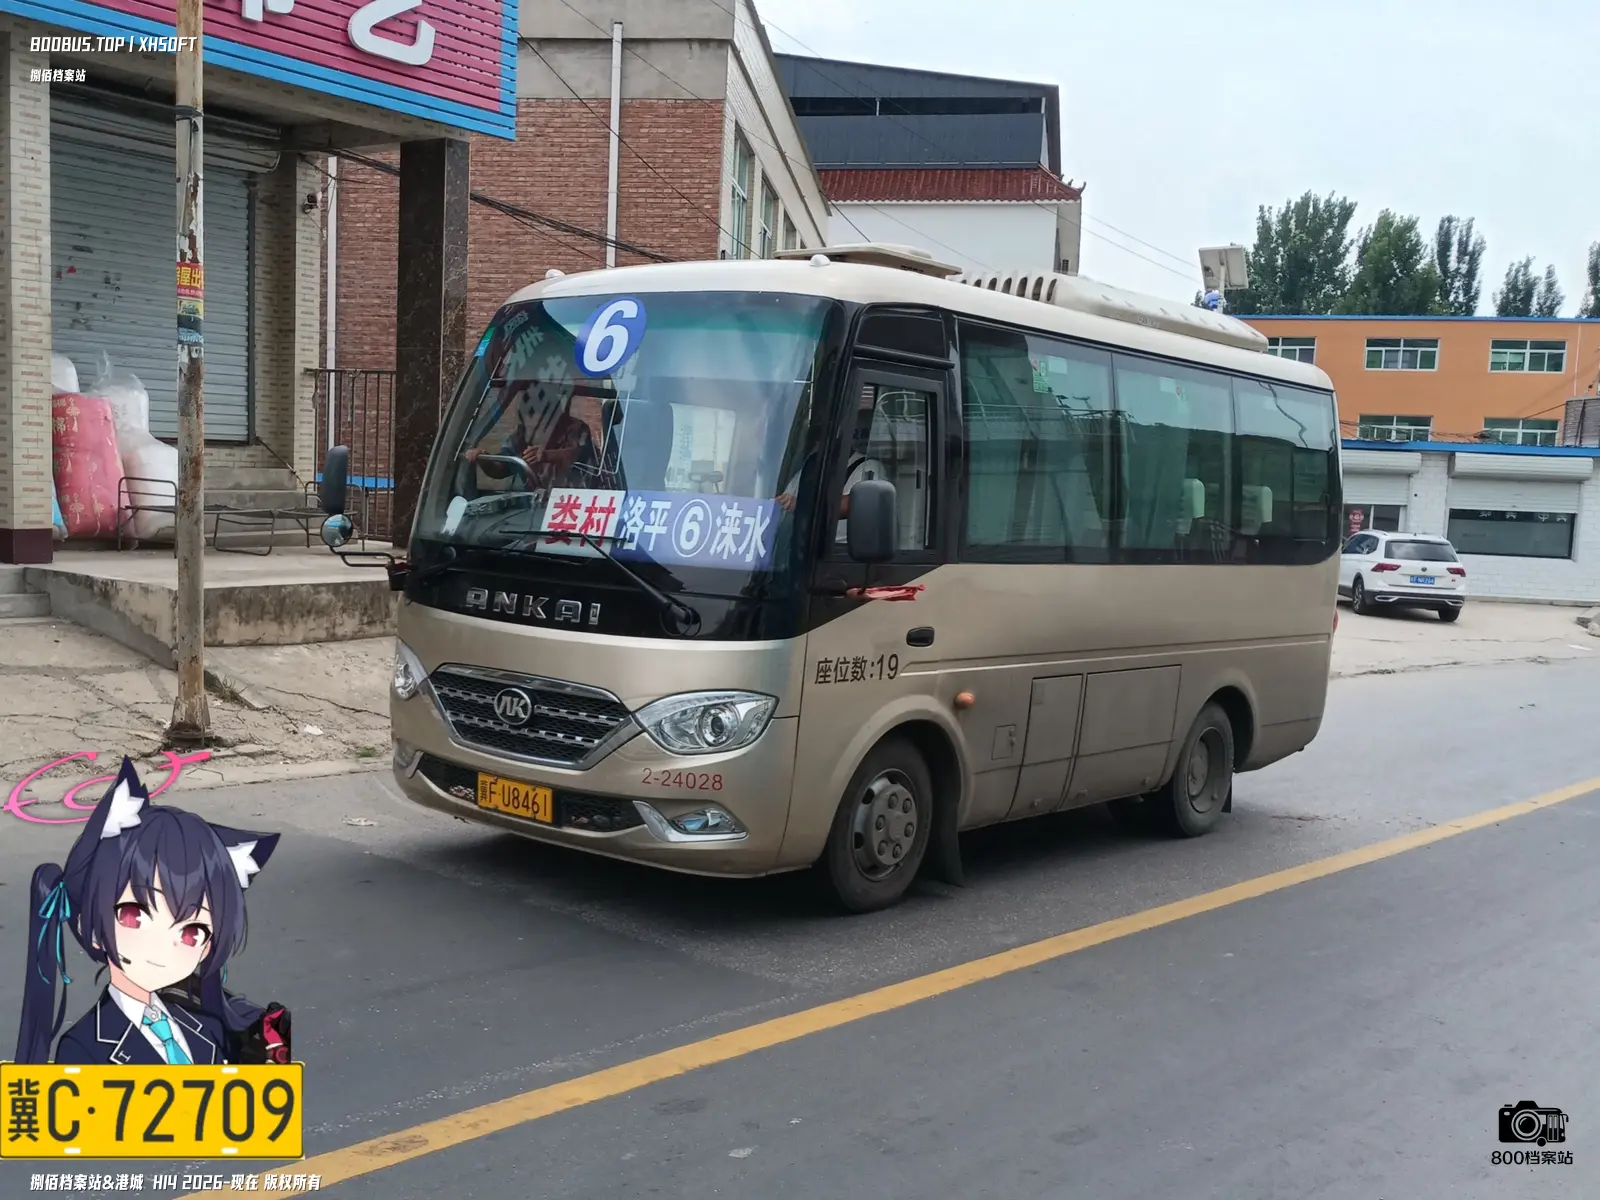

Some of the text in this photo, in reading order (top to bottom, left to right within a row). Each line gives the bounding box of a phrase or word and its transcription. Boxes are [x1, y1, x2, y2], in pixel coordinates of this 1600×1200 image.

[584, 299, 638, 373] 6
[465, 587, 601, 625] ANKAI
[642, 768, 723, 791] 2-24028
